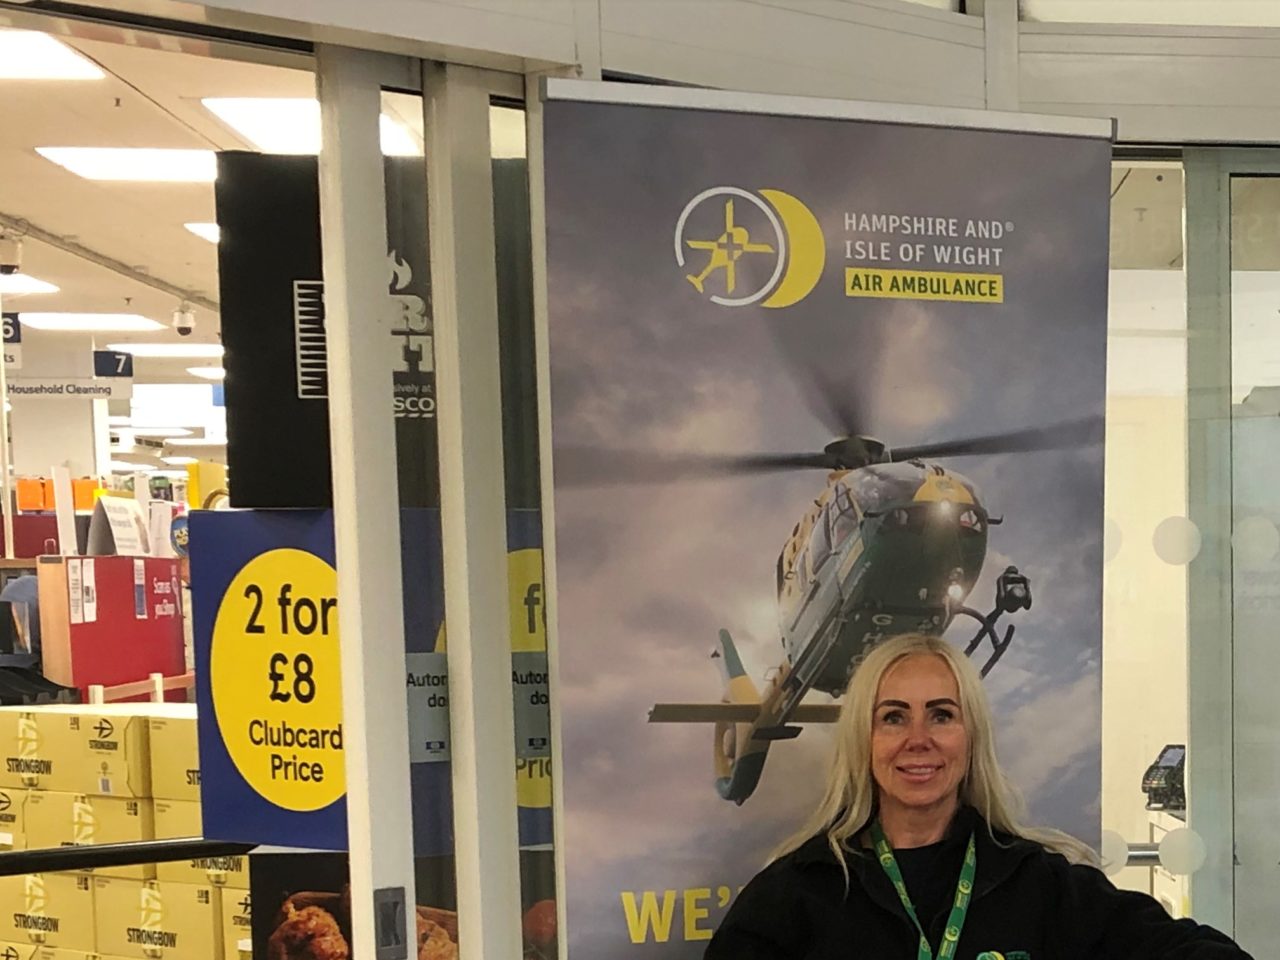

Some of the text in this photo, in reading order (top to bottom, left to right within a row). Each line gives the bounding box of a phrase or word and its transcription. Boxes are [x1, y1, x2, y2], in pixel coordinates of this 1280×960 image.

[844, 213, 958, 237] HAMPSHIRE
[845, 241, 1003, 266] ISLE OF WIGHT
[851, 274, 998, 297] AIR AMBULANCE
[2, 318, 14, 339] 6
[115, 355, 127, 373] 7
[7, 384, 112, 395] Household Cleaning
[394, 397, 435, 412] SCO
[244, 583, 337, 635] 2 for
[268, 652, 316, 704] £8
[248, 719, 343, 750] Clubcard
[6, 757, 53, 775] STRONGBOW
[270, 754, 324, 783] Price
[13, 913, 60, 933] STRONGBOW
[621, 886, 742, 944] WE'
[127, 928, 178, 948] STRONGBOW
